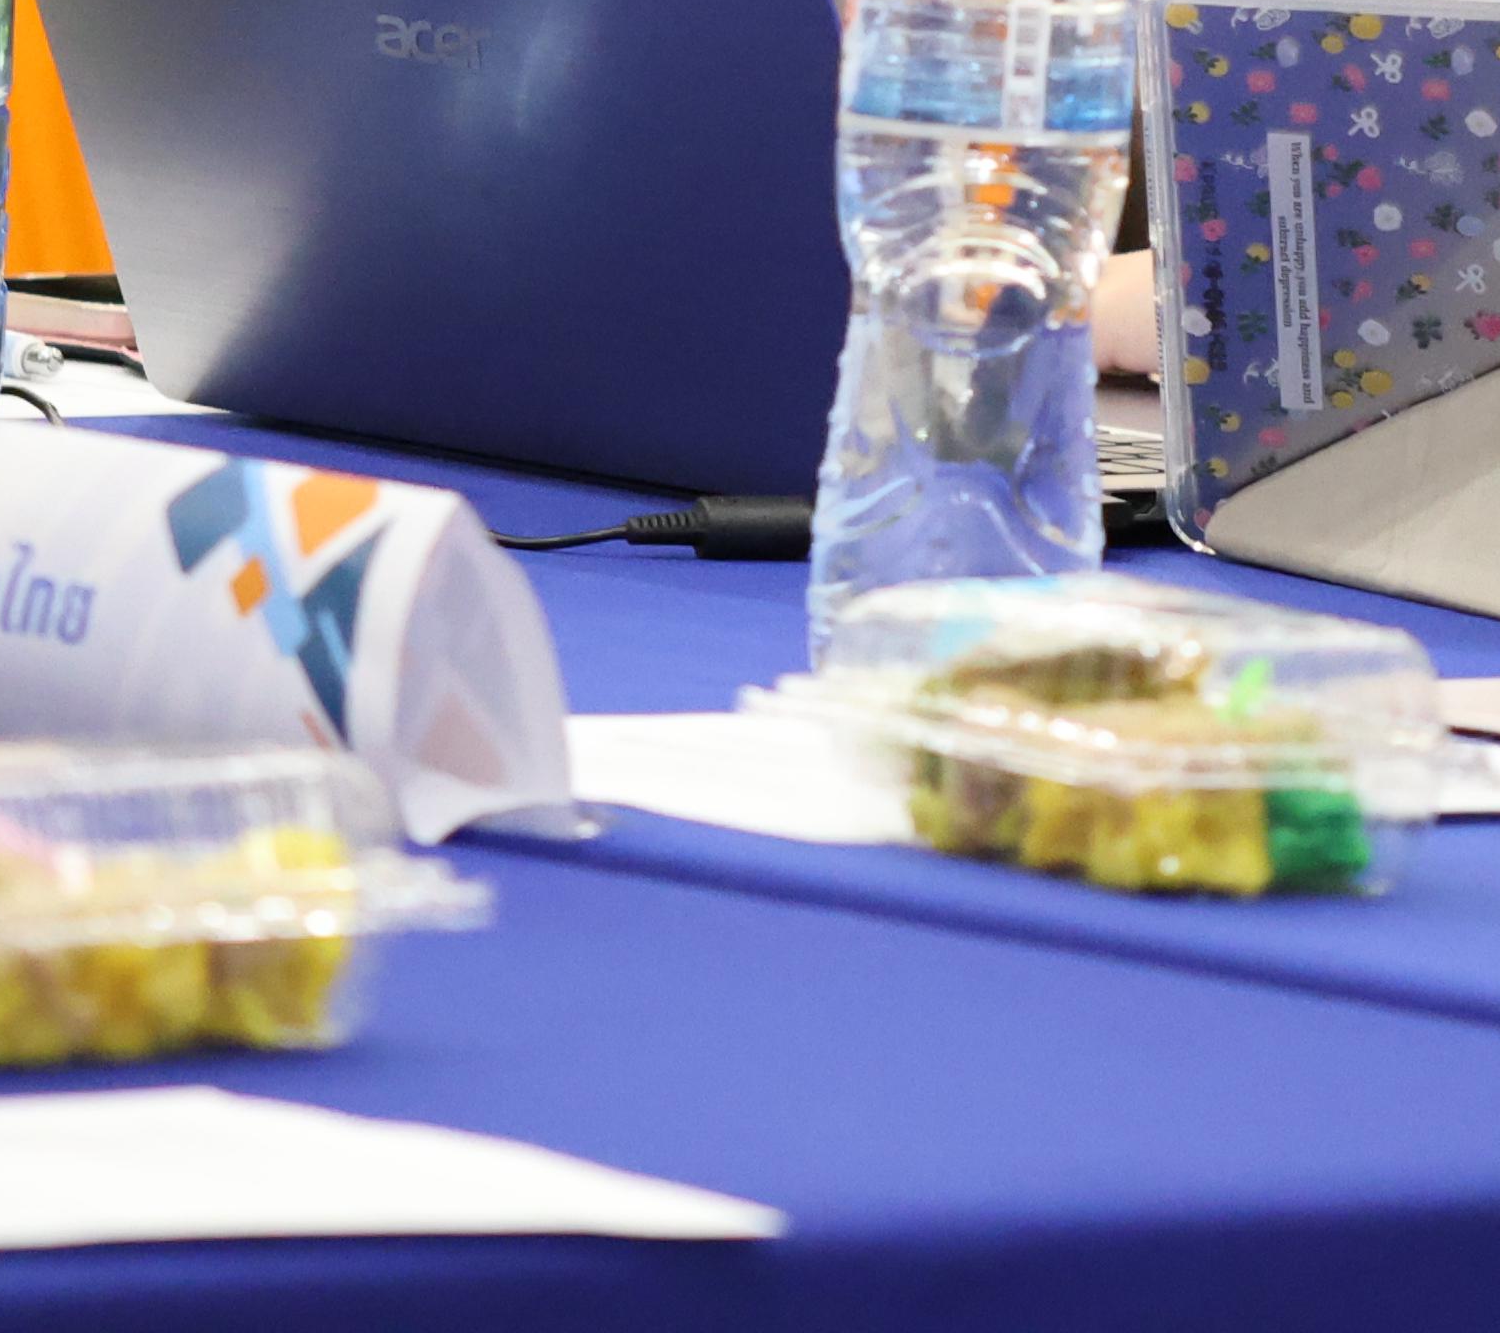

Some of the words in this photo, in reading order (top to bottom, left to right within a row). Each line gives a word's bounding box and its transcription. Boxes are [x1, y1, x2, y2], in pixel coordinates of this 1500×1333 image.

[376, 14, 491, 69] acer
[1291, 141, 1303, 174] When
[1290, 177, 1301, 197] you
[1293, 201, 1303, 218] are
[1278, 265, 1292, 327] depression
[1299, 299, 1311, 320] add
[1297, 323, 1311, 379] happiness
[1303, 382, 1315, 404] and
